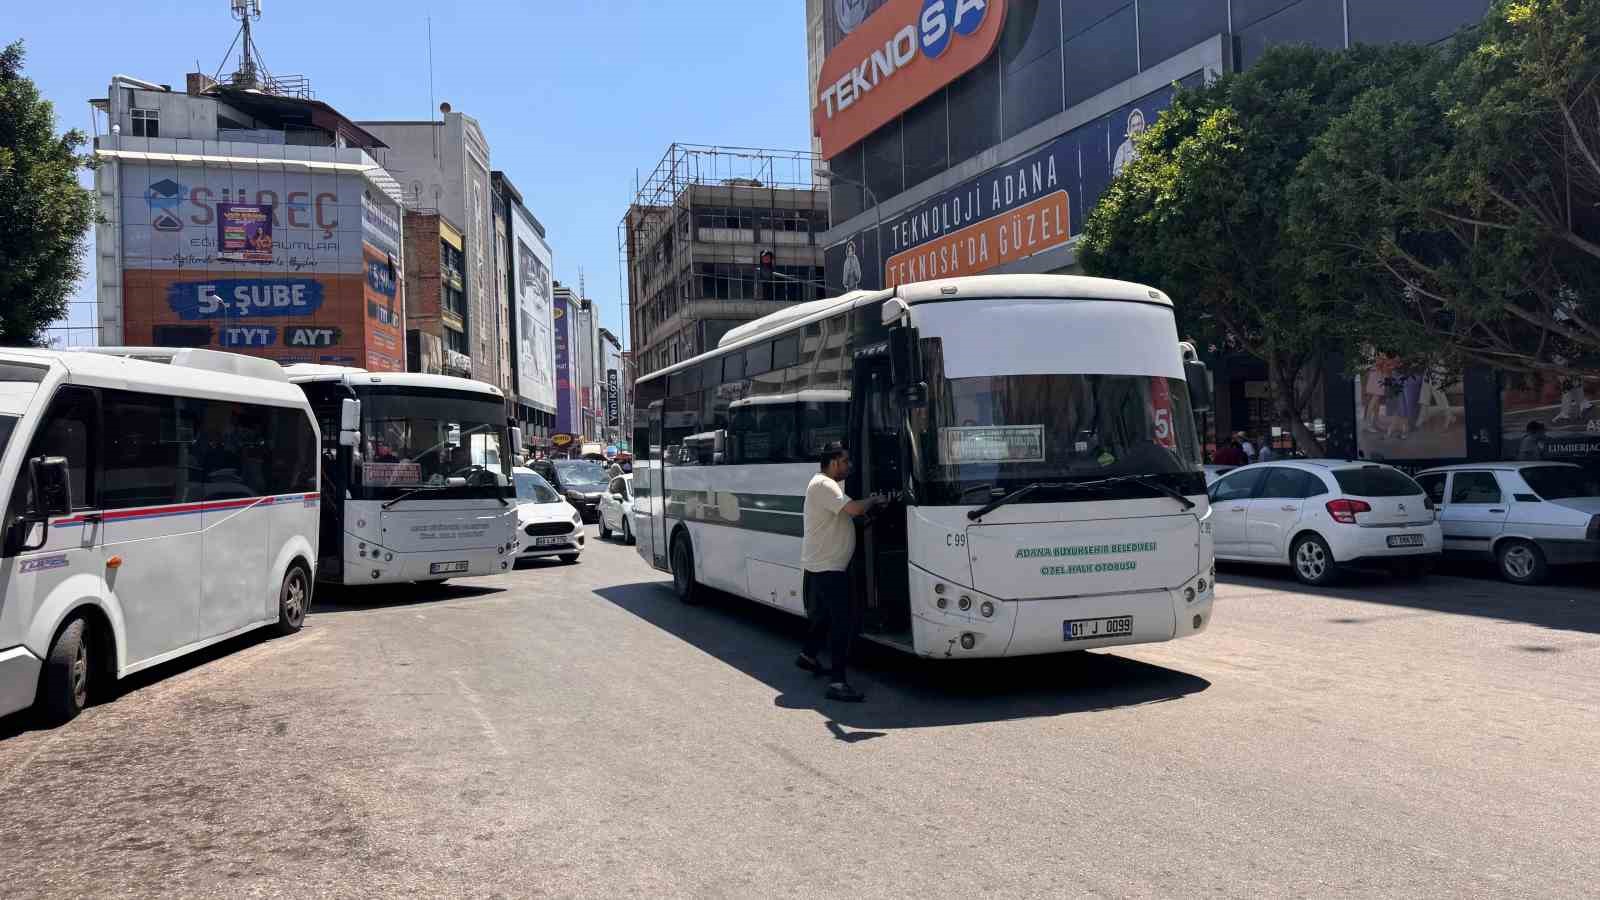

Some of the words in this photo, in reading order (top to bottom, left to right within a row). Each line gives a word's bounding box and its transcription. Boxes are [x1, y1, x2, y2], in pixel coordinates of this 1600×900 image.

[821, 0, 985, 119] TEKNOSA
[892, 182, 981, 250] TEKNOLOJİ
[992, 154, 1057, 211] ADANA
[889, 231, 989, 290] TEKNOSA'DA
[1000, 204, 1065, 255] GÜZEL
[234, 284, 306, 315] ŞUBE
[226, 328, 272, 345] TYT
[291, 328, 334, 346] AYT
[1072, 623, 1083, 636] 01
[1091, 621, 1098, 634] J
[1106, 619, 1130, 633] 0099
